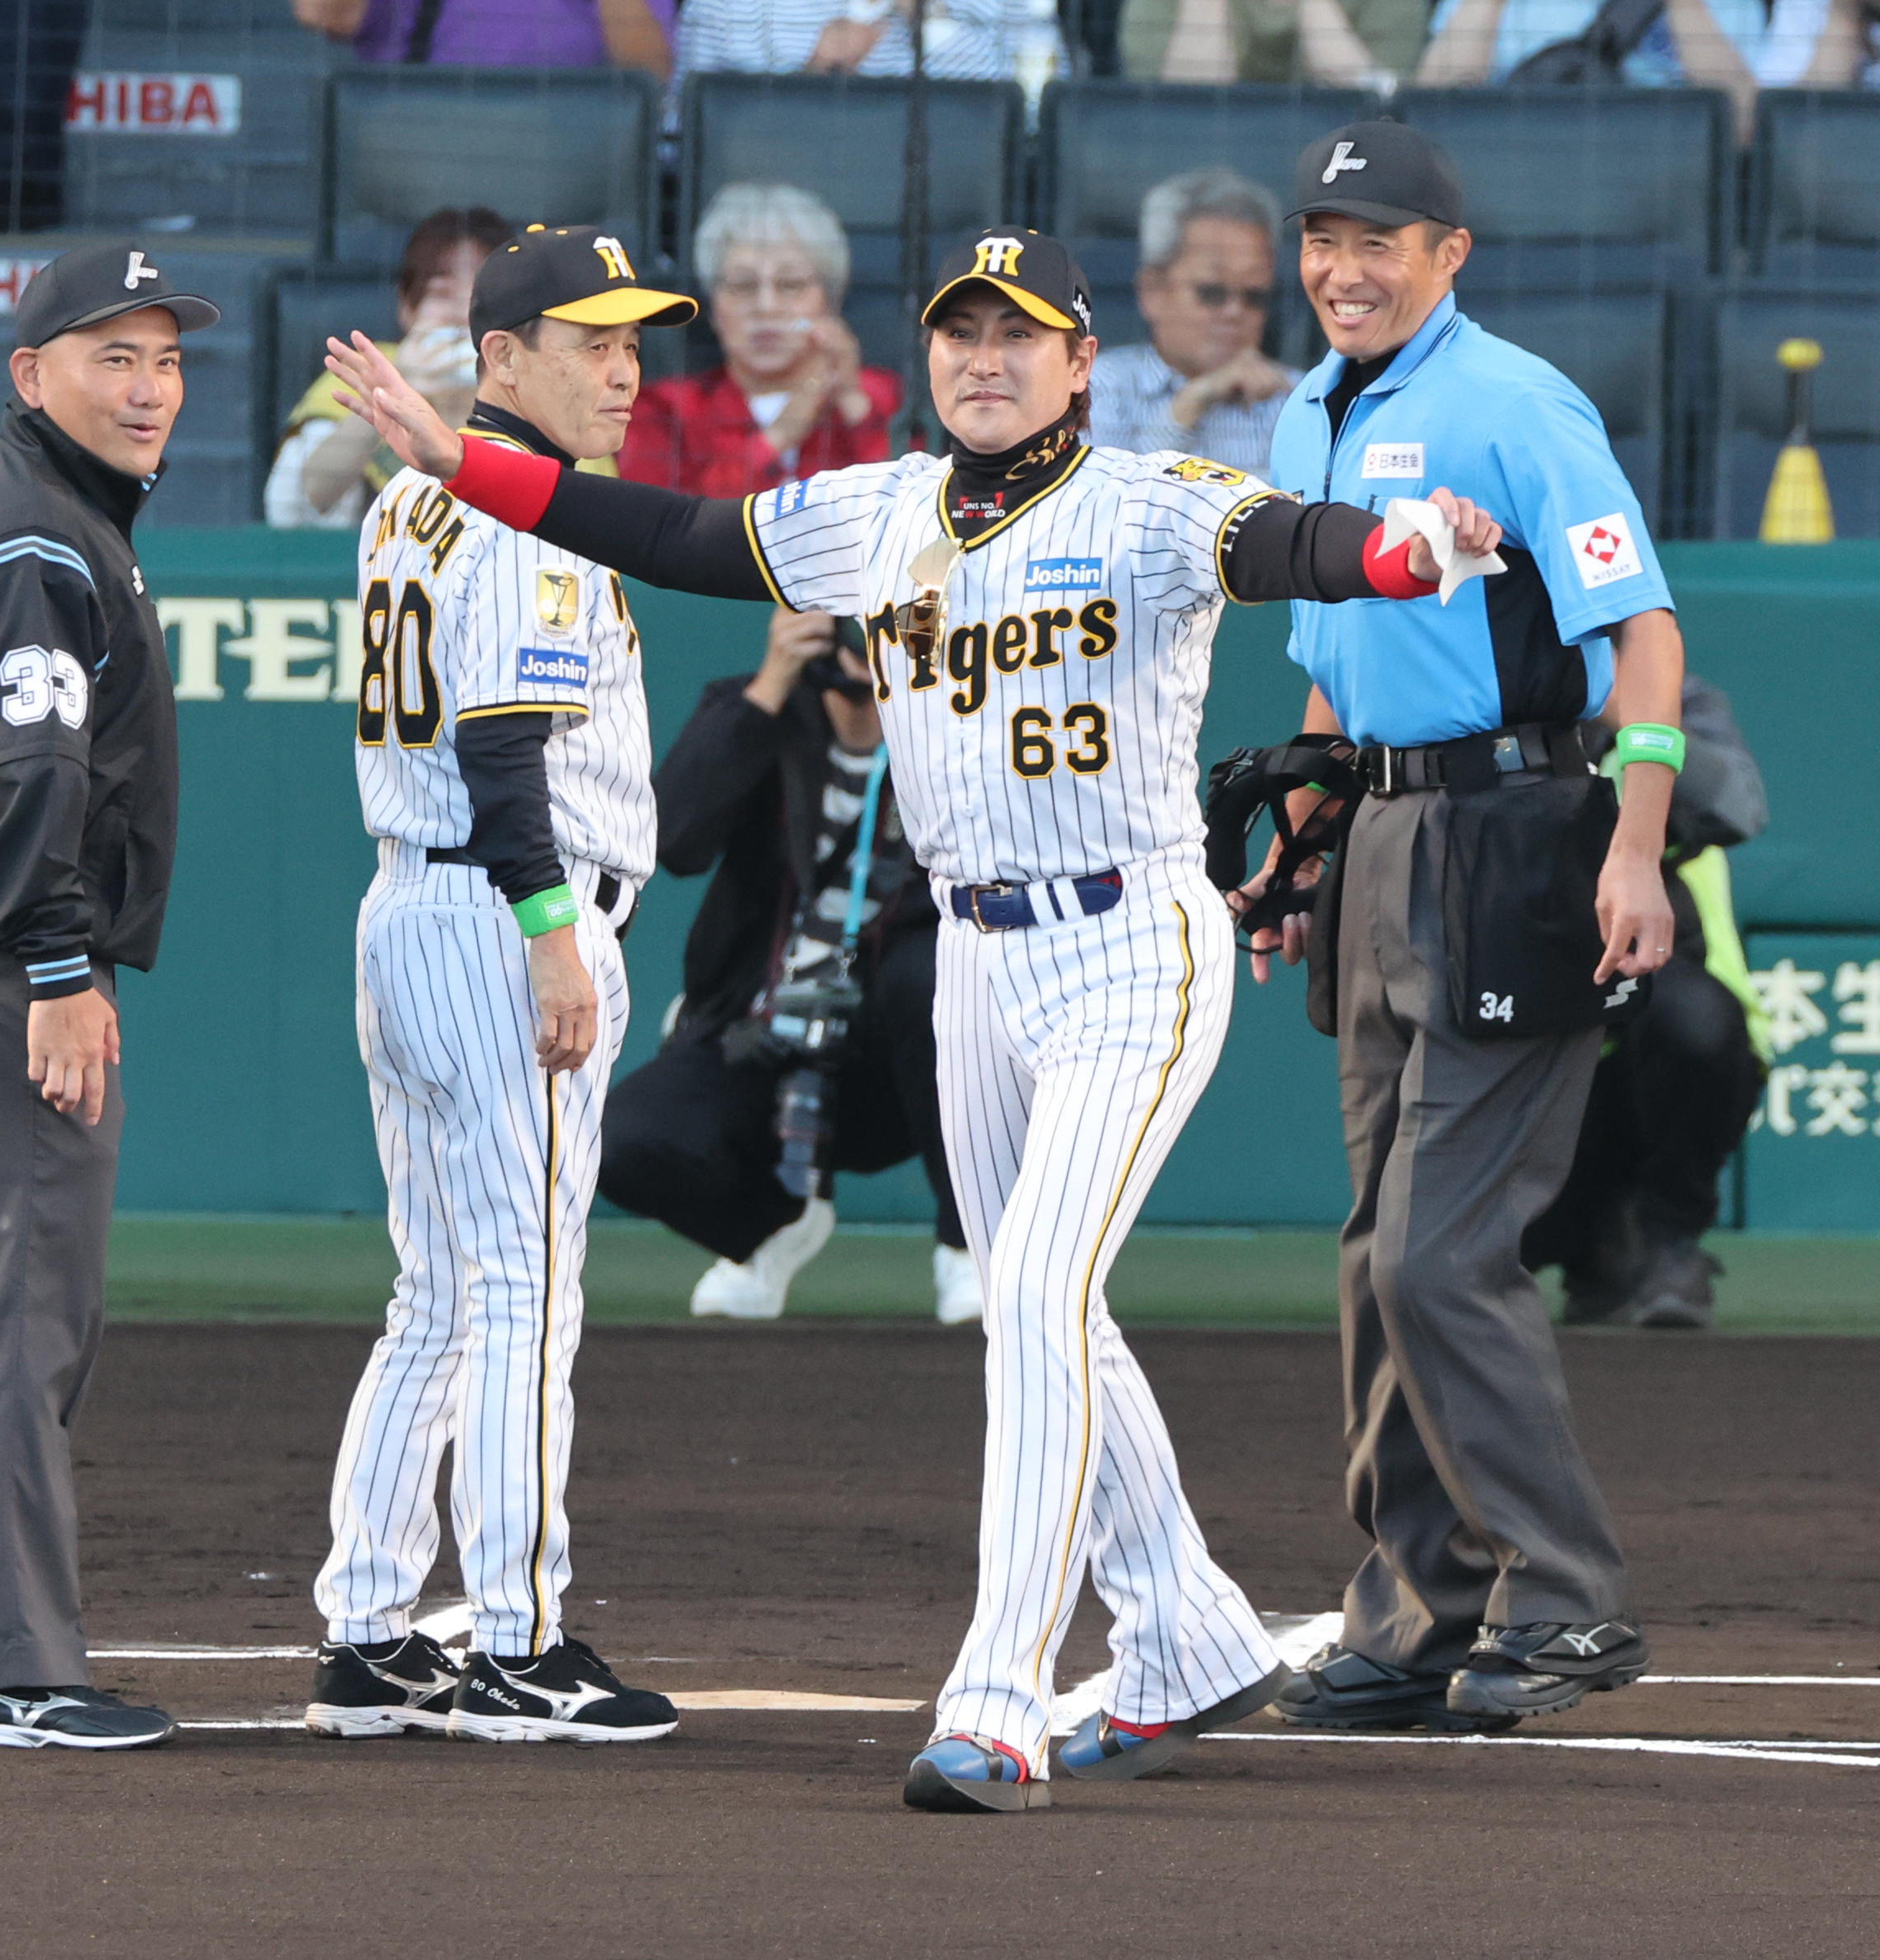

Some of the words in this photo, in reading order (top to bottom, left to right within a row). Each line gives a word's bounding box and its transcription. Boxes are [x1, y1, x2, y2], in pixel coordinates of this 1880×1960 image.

[1026, 564, 1100, 586] Joshin
[0, 644, 88, 730] 33
[357, 577, 445, 748] 80
[521, 655, 587, 682] Joshin
[865, 598, 1120, 717] Tigers
[1011, 701, 1112, 780] 63
[1479, 991, 1514, 1022] 34
